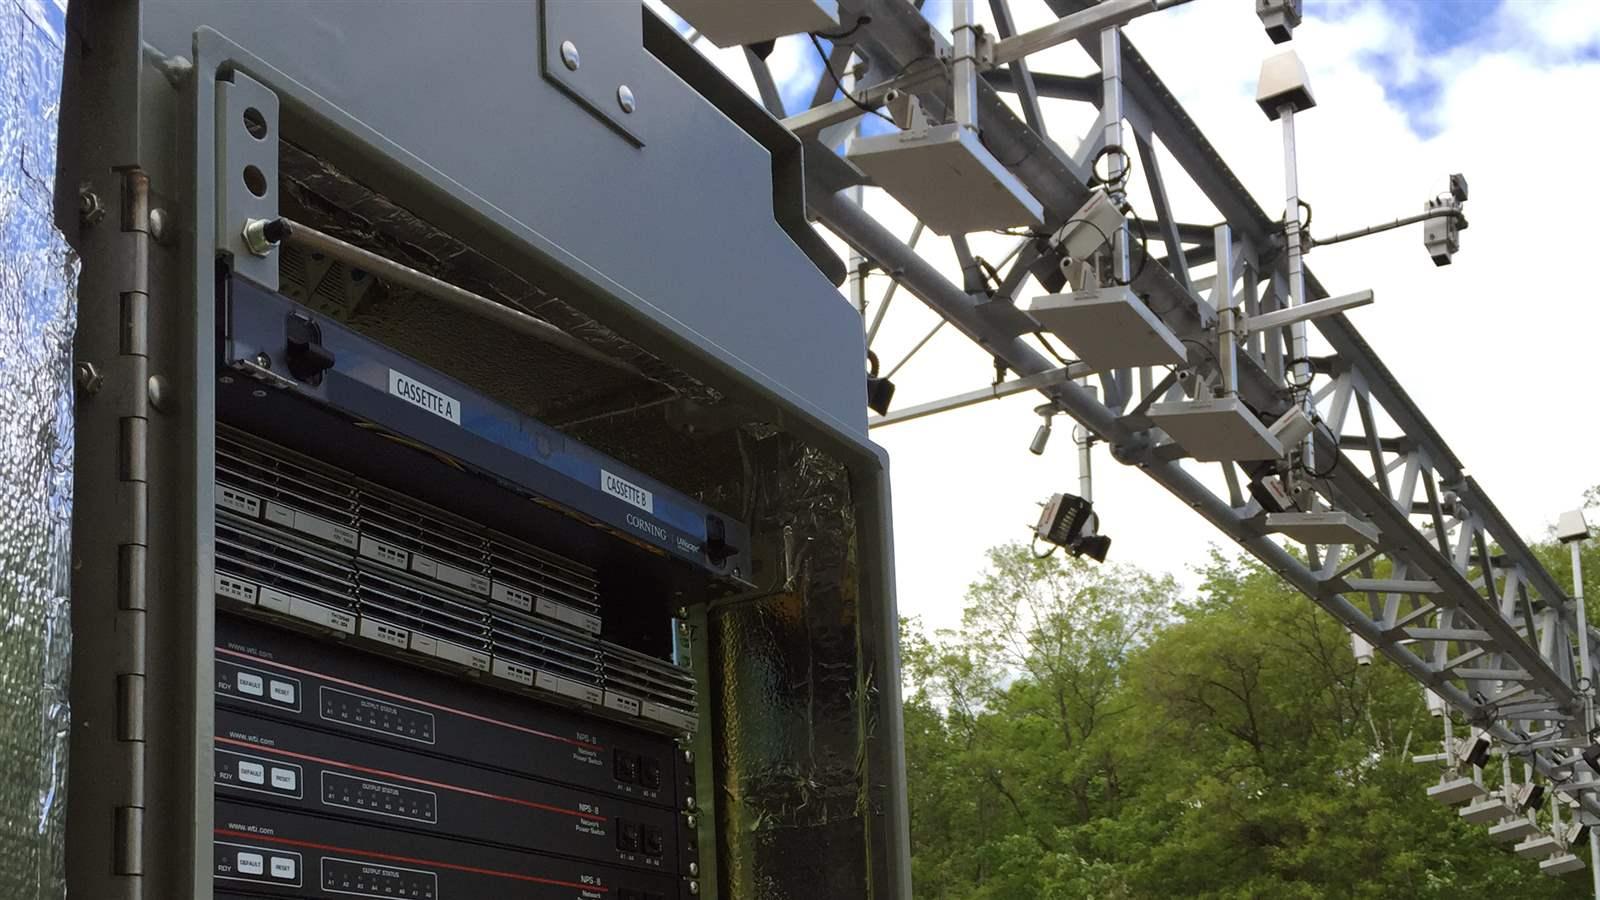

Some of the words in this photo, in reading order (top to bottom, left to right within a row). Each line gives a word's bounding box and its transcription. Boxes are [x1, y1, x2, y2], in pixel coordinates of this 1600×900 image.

[397, 378, 443, 414] CASSETTE
[446, 401, 453, 418] A
[607, 476, 640, 504] CASSETTE
[641, 492, 647, 507] B
[626, 513, 667, 541] CORNING
[218, 681, 231, 690] RDY
[219, 772, 233, 780] RDY
[218, 864, 232, 872] RDY
